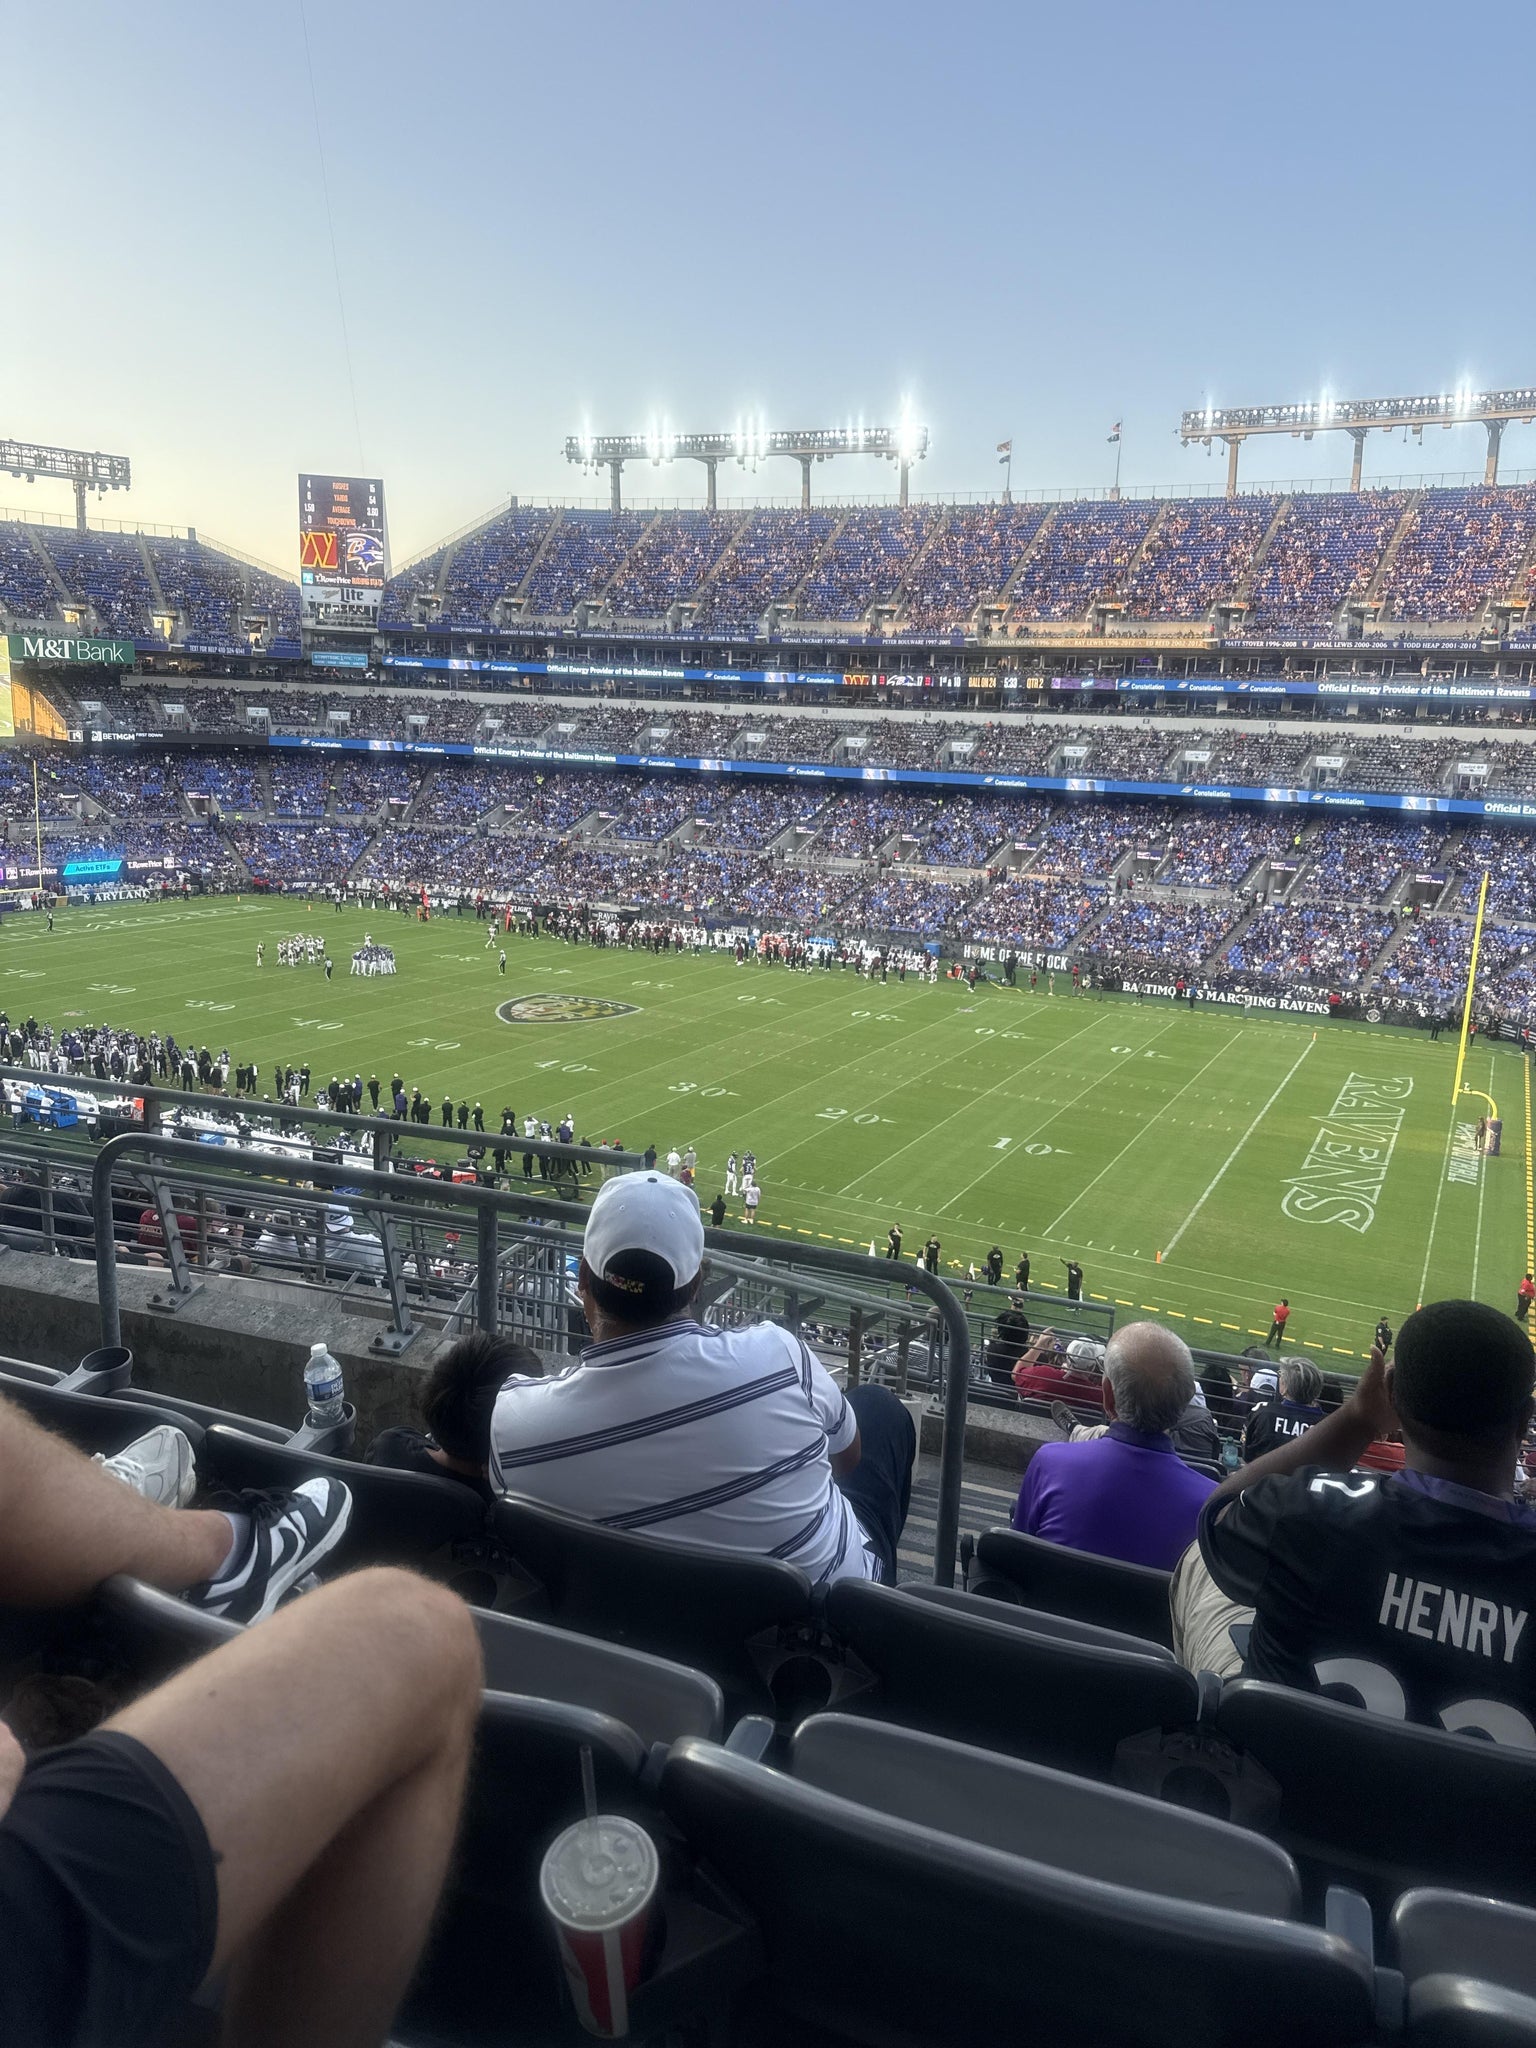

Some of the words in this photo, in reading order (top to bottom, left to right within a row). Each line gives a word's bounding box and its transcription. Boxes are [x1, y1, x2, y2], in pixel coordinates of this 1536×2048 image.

[331, 505, 352, 514] AVERAGE
[341, 588, 365, 603] Lite
[22, 636, 75, 659] M&T
[77, 640, 125, 663] Bank
[1312, 641, 1333, 649] JAMAL
[546, 665, 569, 673] Official
[569, 666, 589, 675] Energy
[590, 667, 615, 675] Provider
[633, 669, 662, 677] Baltimore
[662, 670, 685, 678] Ravens
[916, 676, 924, 686] 17
[954, 677, 962, 687] 10
[968, 677, 981, 688] BALL
[989, 678, 997, 688] 24
[1026, 678, 1039, 688] QTR
[1190, 684, 1224, 692] Constellation
[1318, 684, 1350, 693] Official
[1351, 684, 1382, 695] Energy
[1383, 686, 1420, 695] Provider
[1421, 687, 1432, 695] of
[1432, 687, 1449, 695] the
[1449, 687, 1496, 697] Baltimore
[1496, 688, 1531, 698] Ravens
[102, 733, 136, 741] BETMGM
[473, 746, 498, 756] Official
[498, 748, 520, 758] Energy
[520, 750, 545, 759] Provider
[564, 753, 594, 762] Baltimore
[594, 755, 617, 763] Ravens
[796, 768, 826, 776] Constellation
[995, 779, 1028, 787] Constellation
[1194, 789, 1231, 797] Constellation
[1325, 796, 1365, 805] Constellation
[1484, 803, 1521, 814] Official
[964, 944, 996, 963] HME
[998, 948, 1012, 963] OF
[1014, 951, 1033, 966] THE
[1036, 953, 1069, 972] FOCK
[1205, 990, 1276, 1009] MARCHING
[1278, 999, 1330, 1015] RAVENS
[1280, 1071, 1414, 1234] RAVENS
[1446, 1140, 1481, 1186] FOOTBALL
[1275, 1416, 1316, 1438] FLAC
[1378, 1571, 1529, 1665] HENRY
